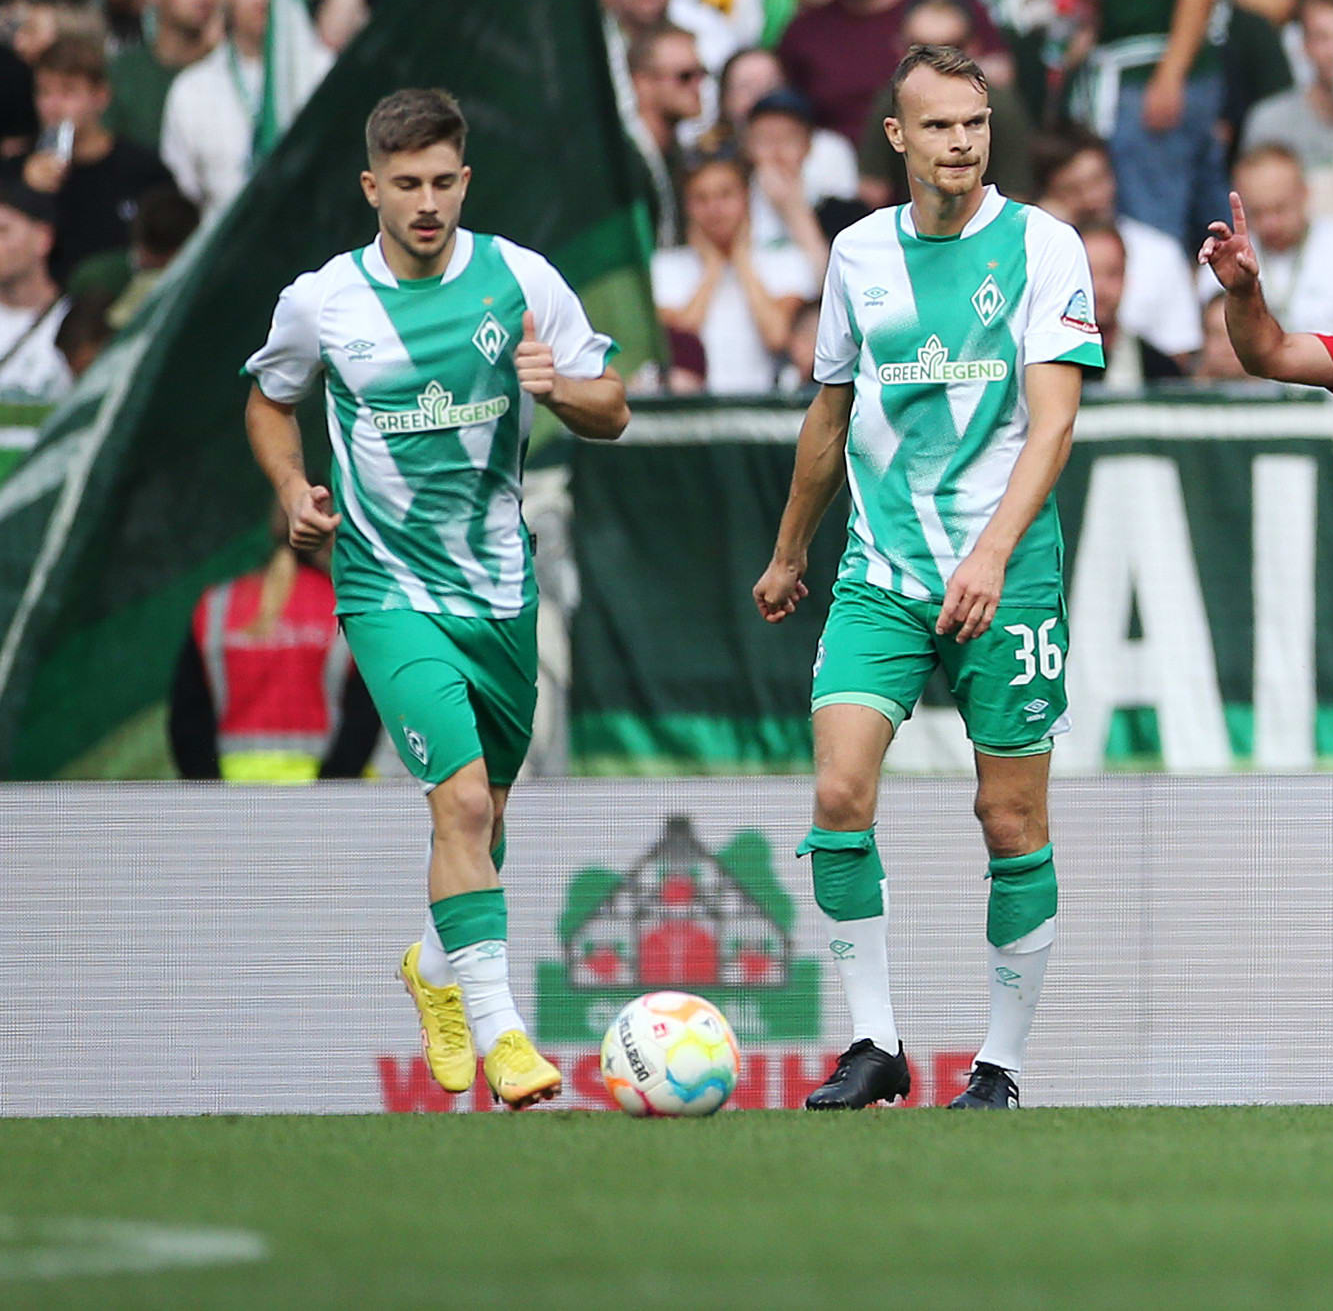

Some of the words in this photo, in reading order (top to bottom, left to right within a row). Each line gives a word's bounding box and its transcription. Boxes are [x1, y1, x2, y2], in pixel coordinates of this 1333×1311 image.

[881, 361, 1005, 382] GREENLEGEND
[373, 395, 508, 431] GREENLEGEND
[1003, 616, 1063, 686] 36
